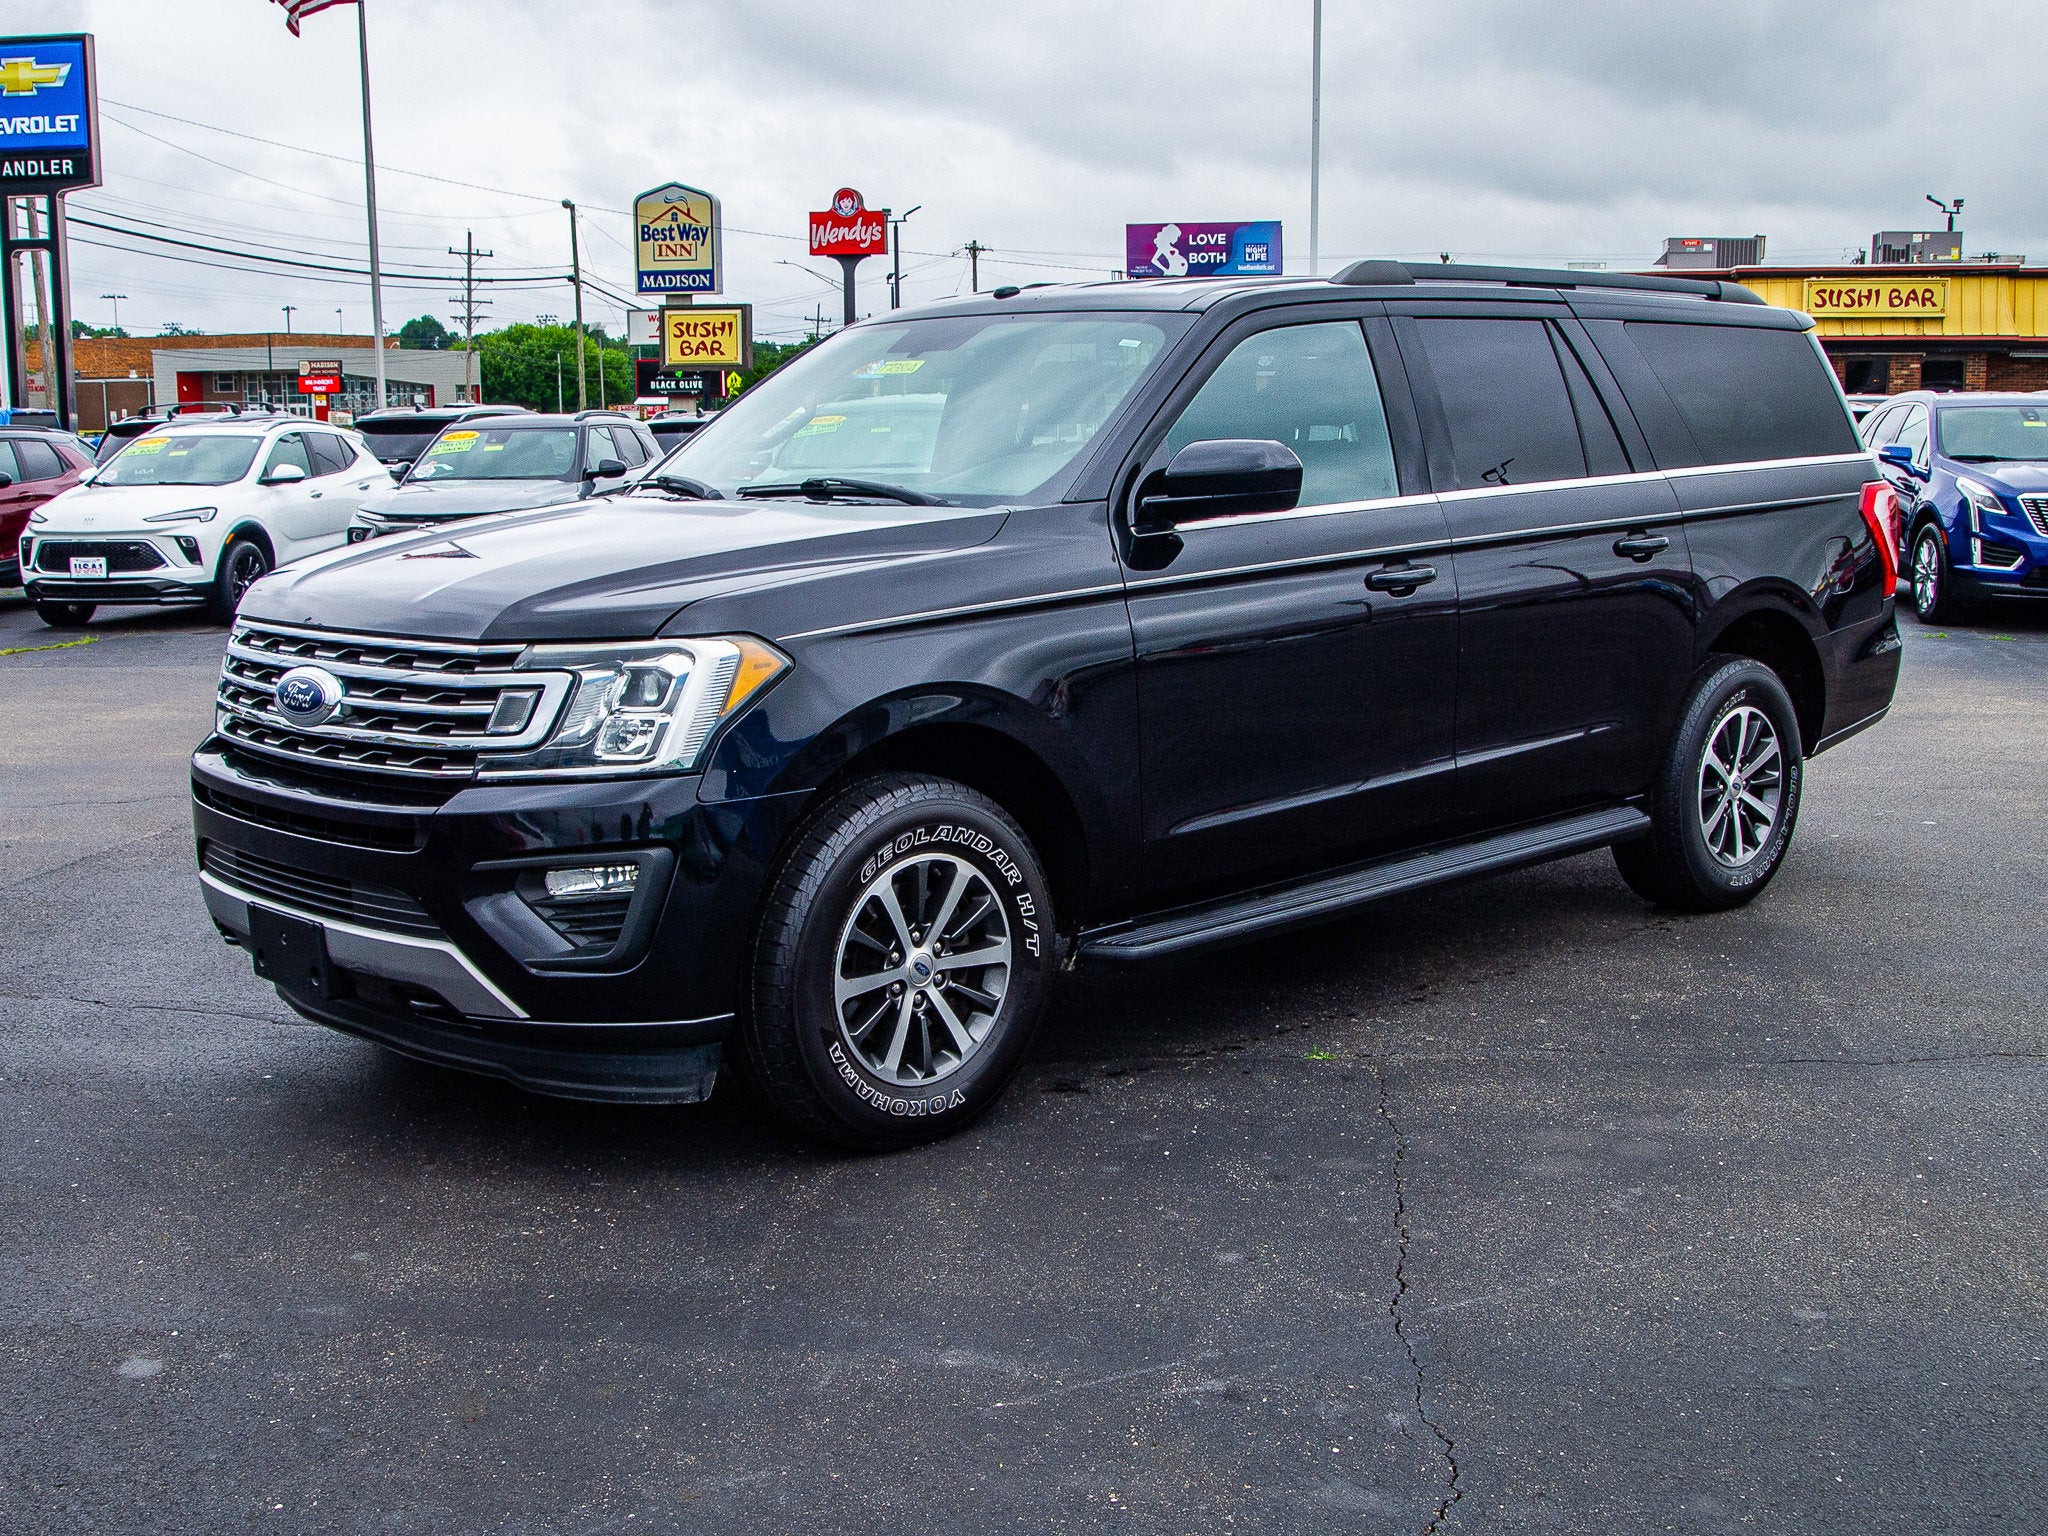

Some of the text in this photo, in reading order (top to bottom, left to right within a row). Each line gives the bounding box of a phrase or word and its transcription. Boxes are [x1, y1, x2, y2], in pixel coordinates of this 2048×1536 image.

[2, 159, 73, 176] ANDLER
[640, 223, 709, 246] Best Way
[811, 217, 882, 249] Wendy's
[1188, 234, 1226, 245] LOVE
[657, 244, 693, 257] INN
[1189, 252, 1226, 264] BOTH
[1245, 253, 1267, 262] LIFE
[642, 274, 710, 288] MADISON
[1814, 288, 1938, 308] SUSHI BAR
[673, 321, 733, 338] SUSHI
[680, 340, 726, 356] BAR
[650, 381, 703, 389] BLACK OLIVE
[283, 681, 314, 708] Ford
[860, 825, 1040, 957] GEOLANDAR H/T
[829, 1041, 966, 1116] YOKOHAMA
